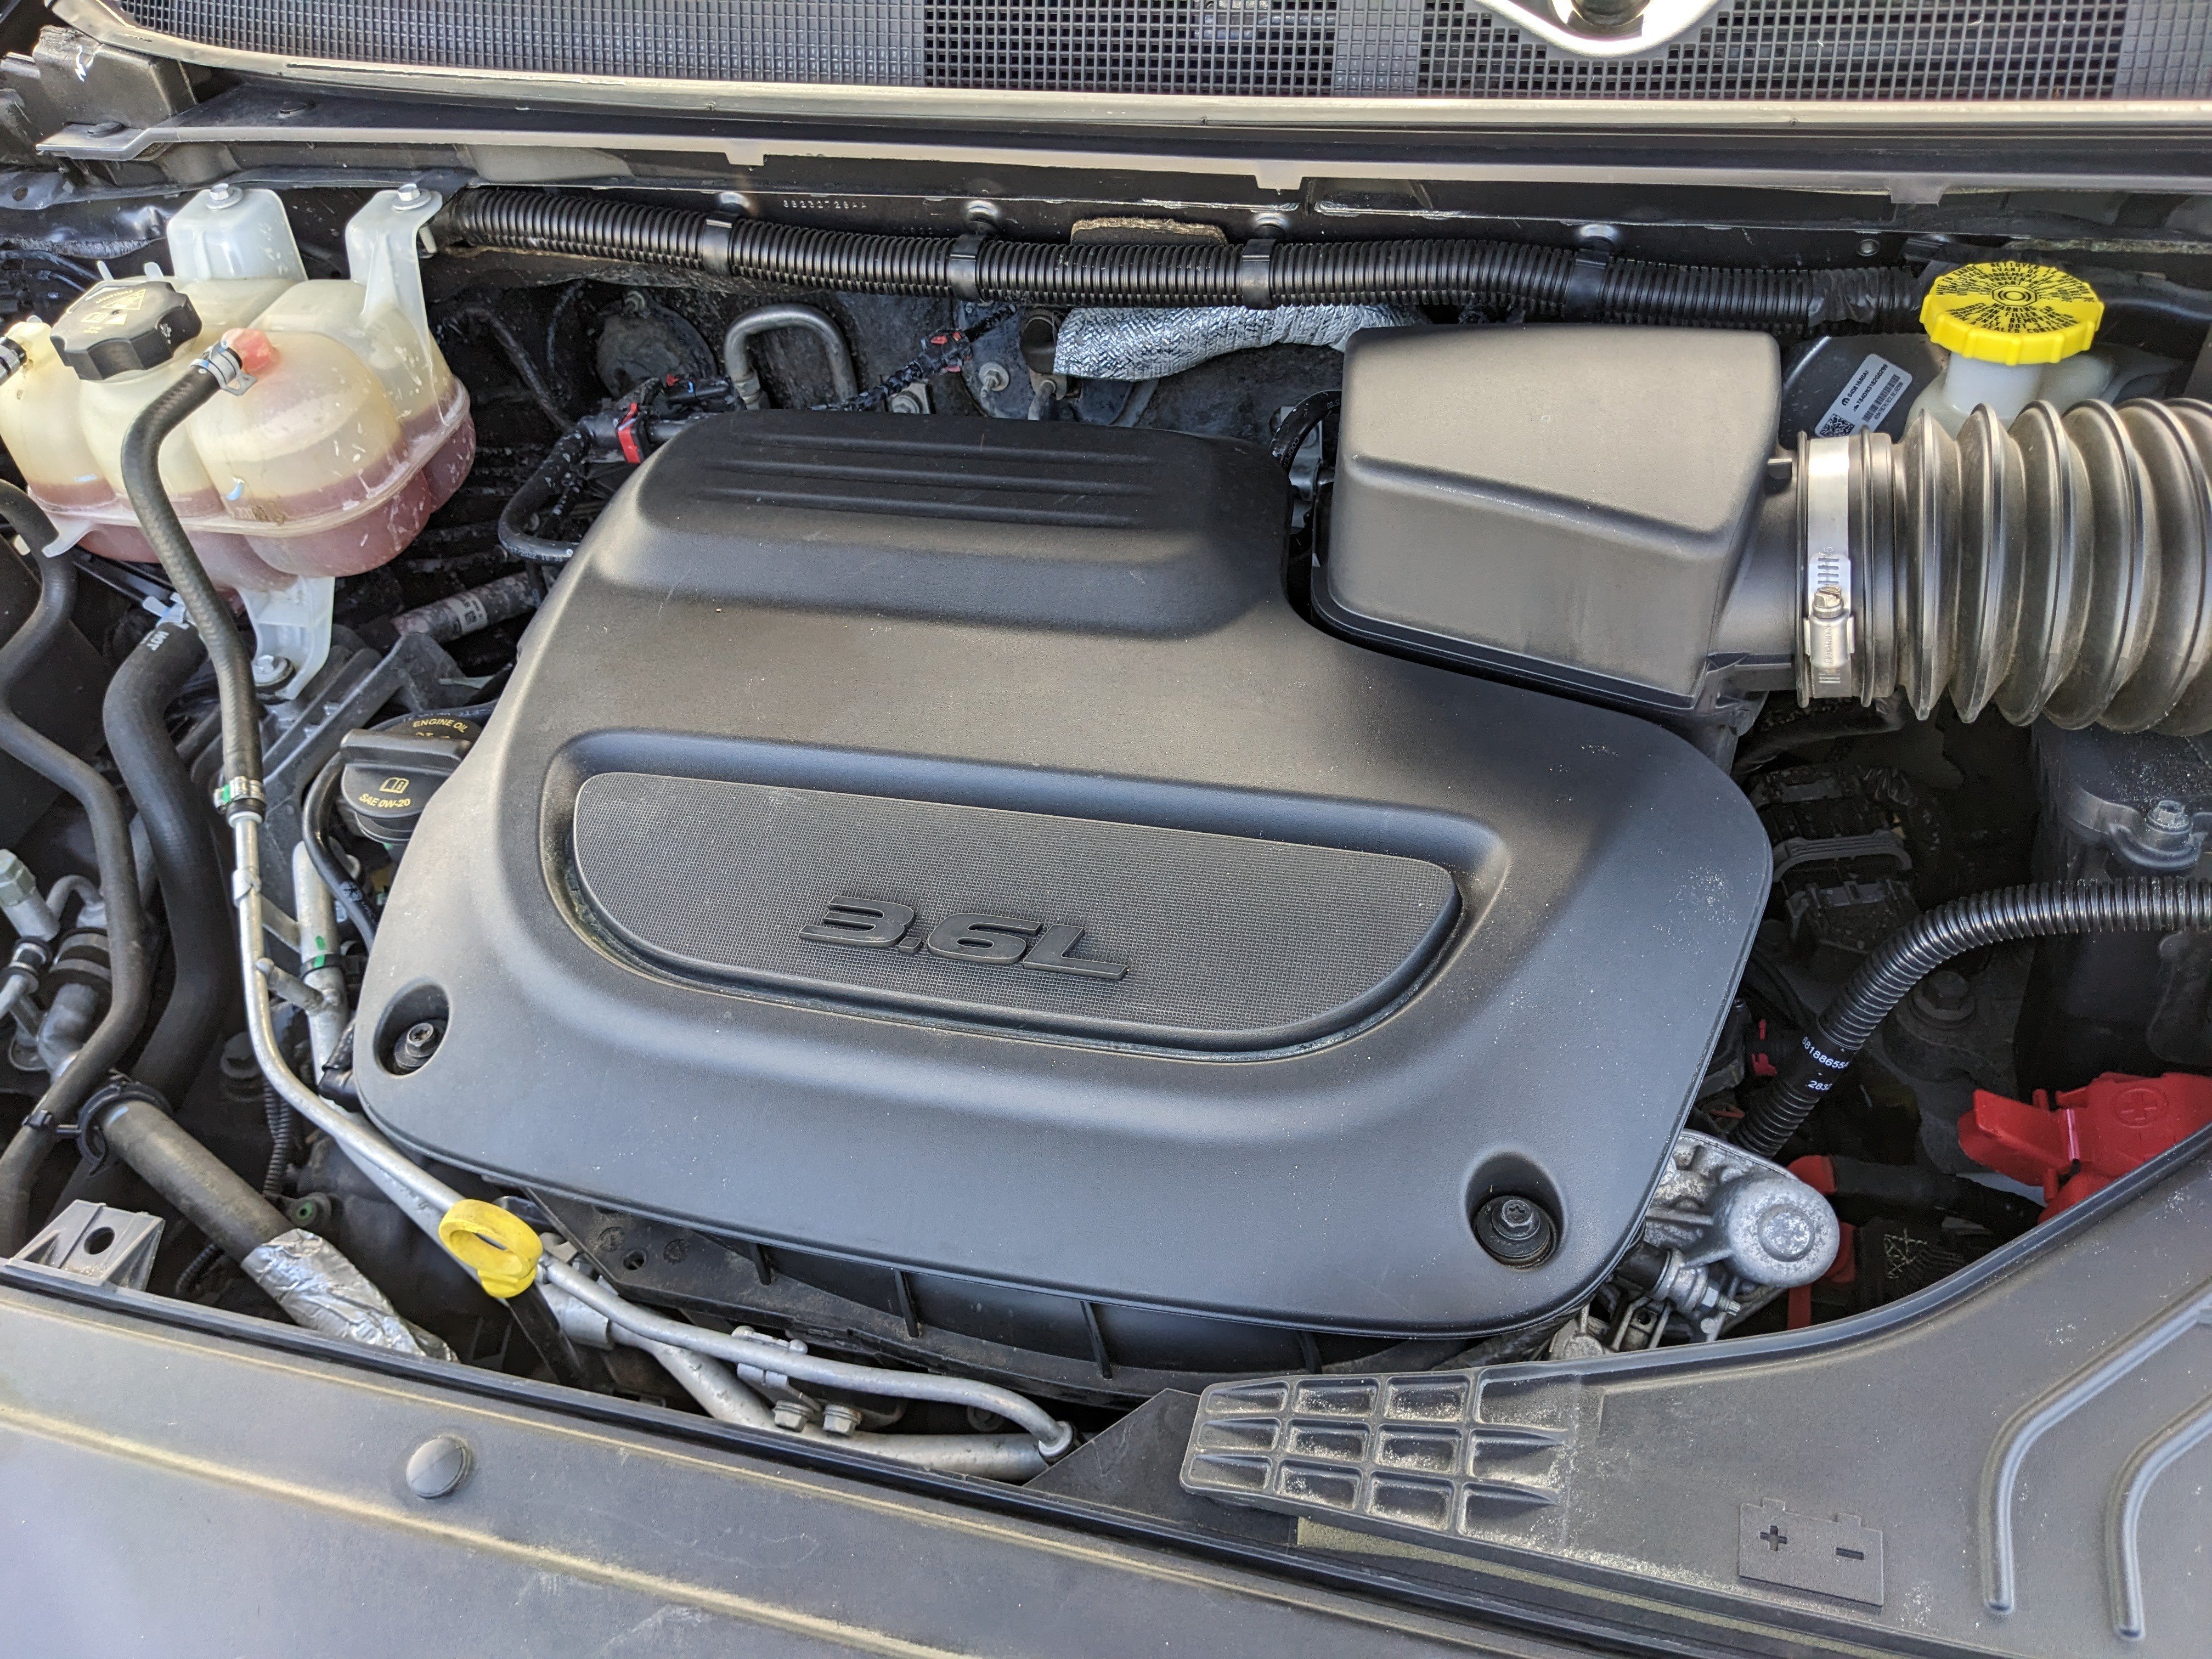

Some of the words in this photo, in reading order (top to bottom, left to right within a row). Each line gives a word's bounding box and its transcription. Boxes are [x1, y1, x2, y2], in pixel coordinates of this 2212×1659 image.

[1991, 303, 2036, 312] WARNING
[1976, 317, 2001, 326] ONLY
[1980, 324, 2019, 333] SEALED
[413, 718, 454, 728] ENGINE
[453, 720, 469, 733] OIL
[359, 793, 380, 806] SAE
[378, 798, 411, 808] 0W-20
[799, 895, 1130, 981] 3.6L
